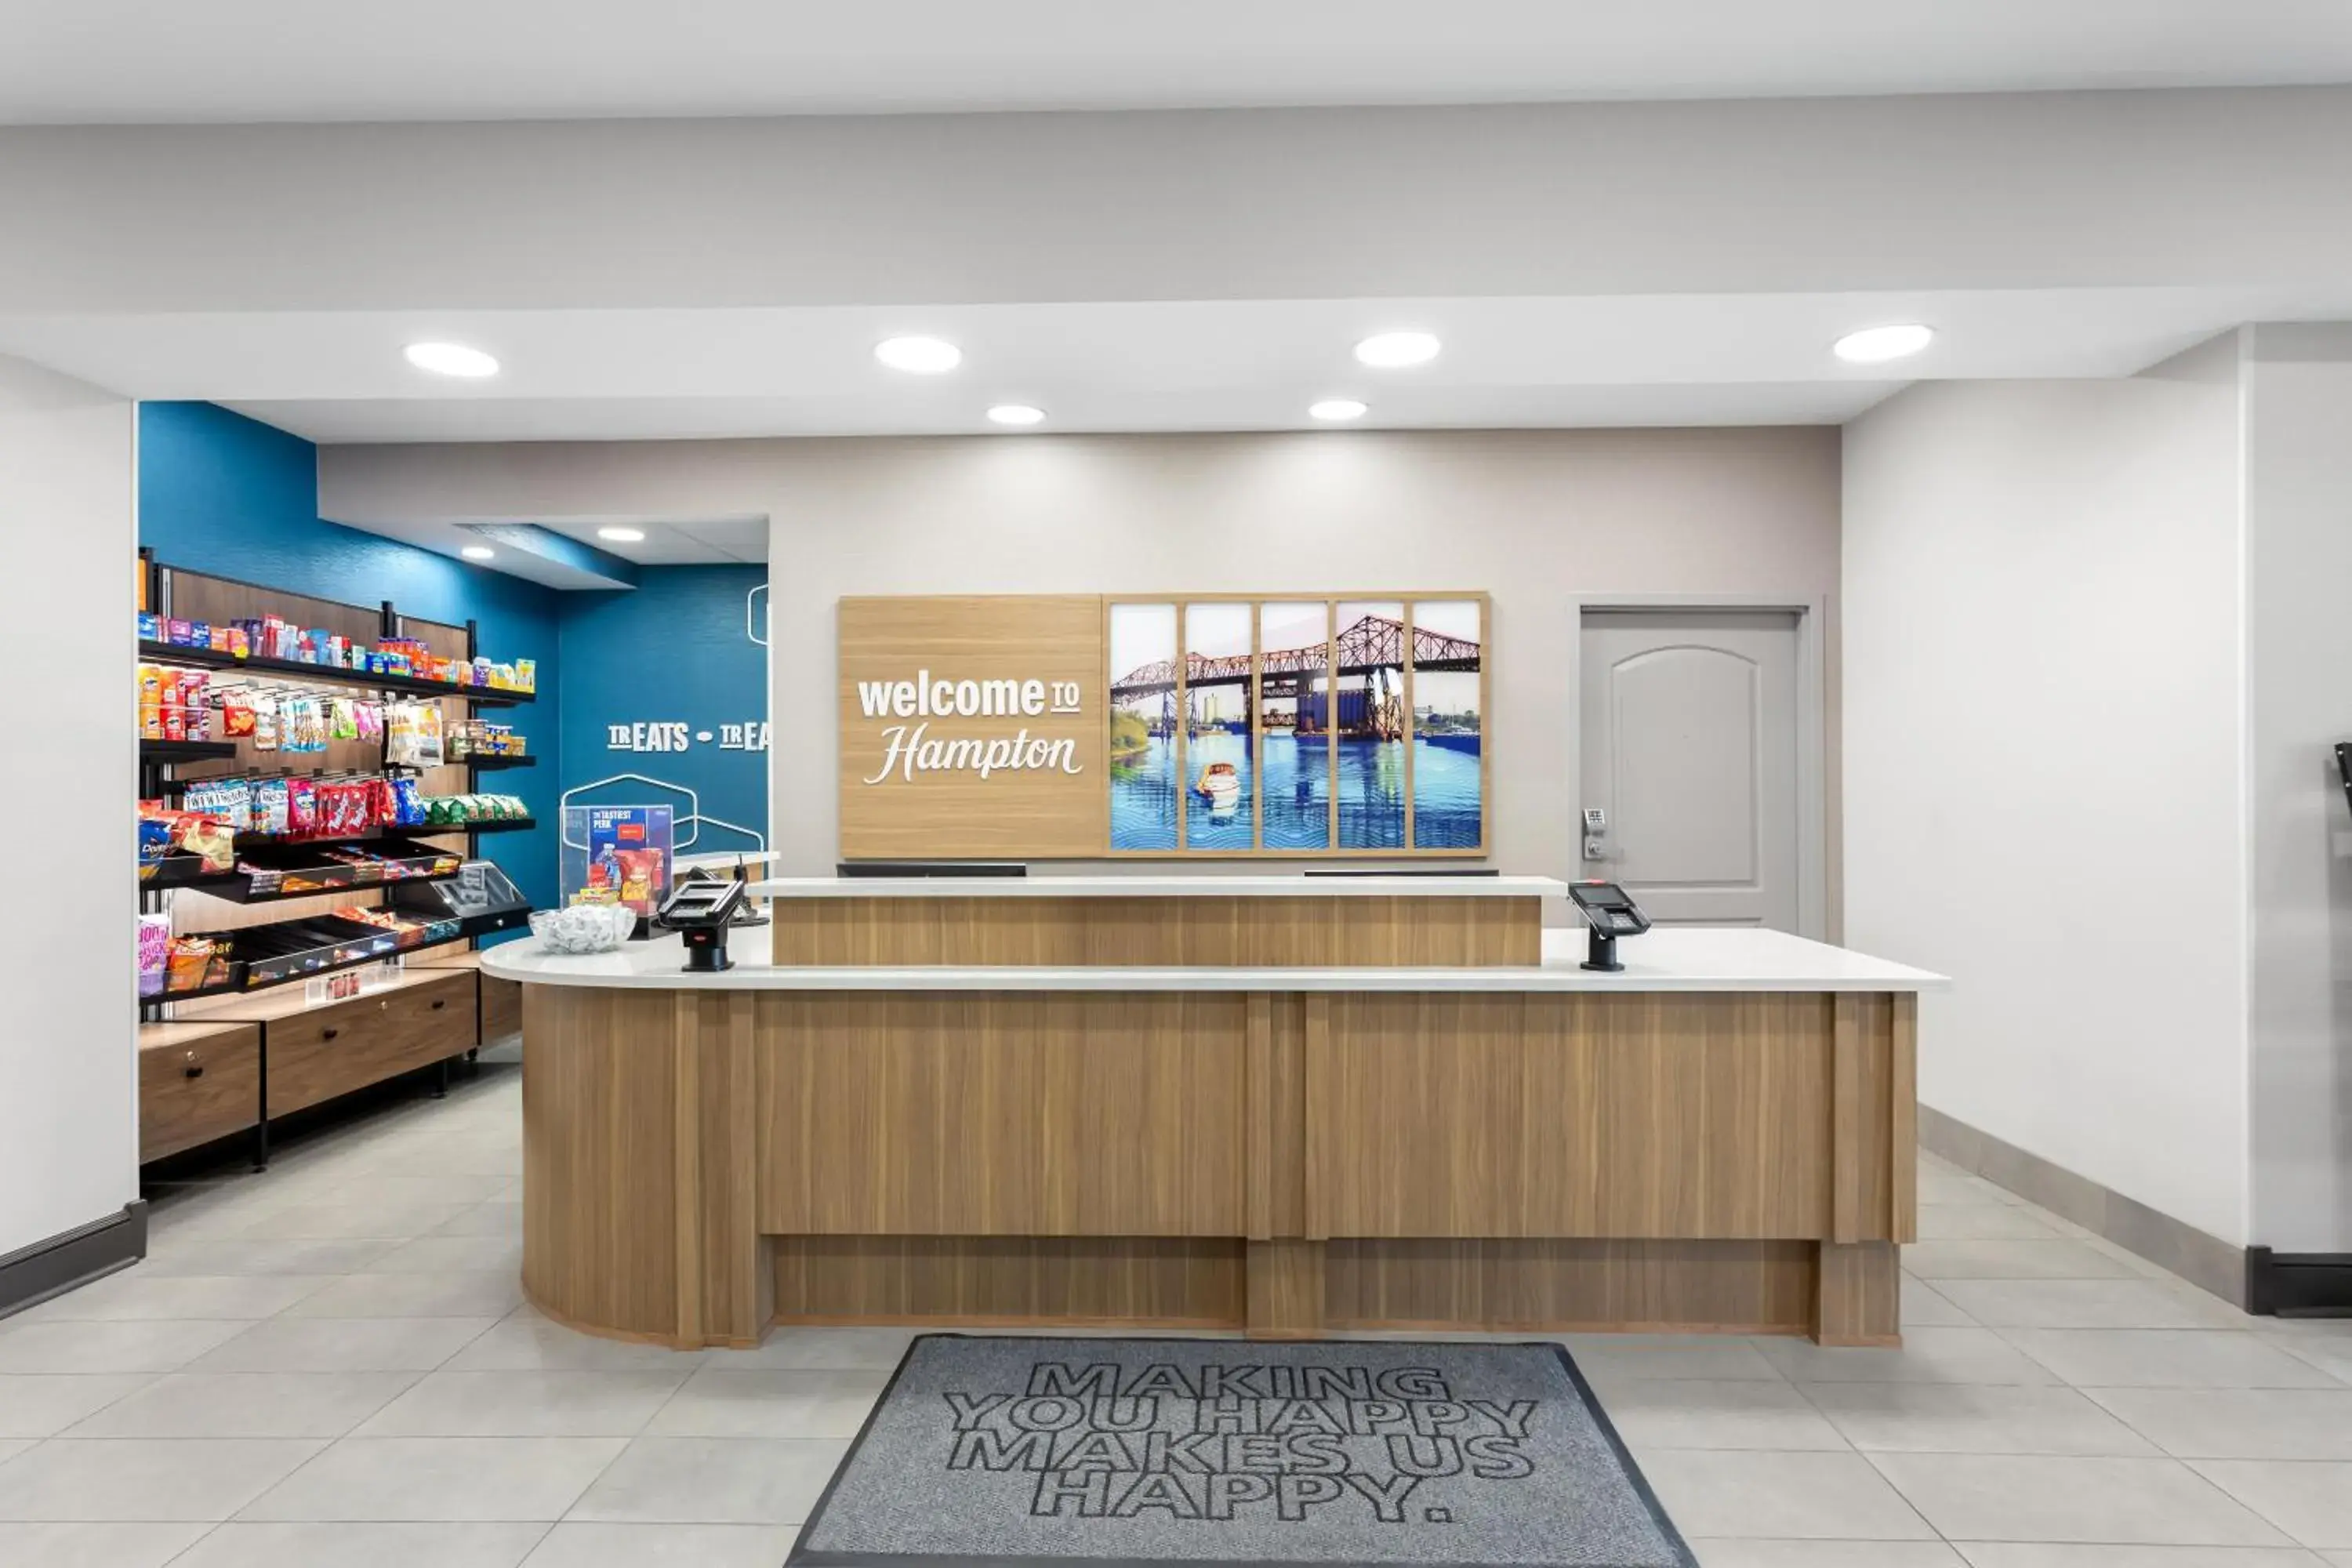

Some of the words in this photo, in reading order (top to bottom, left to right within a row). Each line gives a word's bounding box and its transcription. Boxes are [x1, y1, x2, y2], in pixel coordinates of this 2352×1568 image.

[859, 670, 1045, 717] welcome
[1051, 681, 1081, 713] TO
[863, 722, 1083, 785] Hampton
[1025, 1362, 1453, 1402] MAKING
[943, 1392, 1161, 1434] YOU
[1196, 1396, 1540, 1439] HAPPY
[946, 1428, 1351, 1476] MAKES
[1389, 1433, 1538, 1480] US
[1029, 1471, 1454, 1524] HAPPY.
